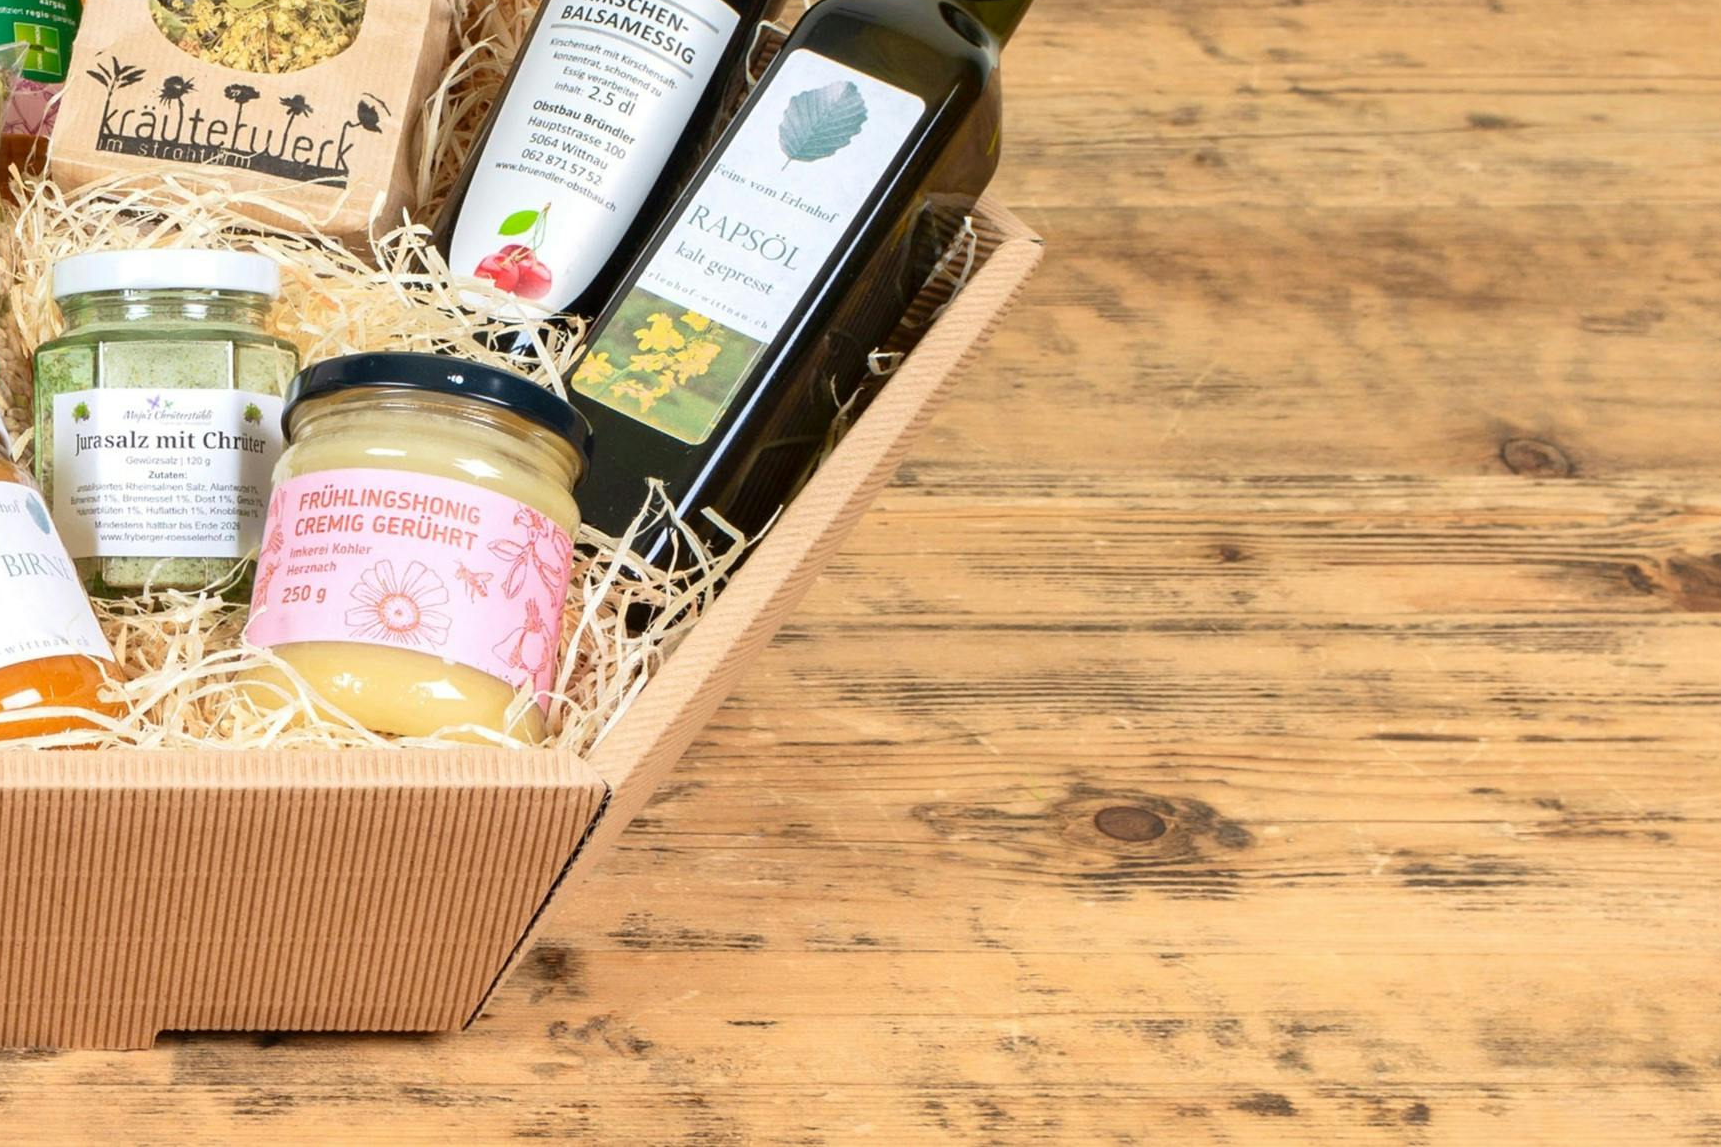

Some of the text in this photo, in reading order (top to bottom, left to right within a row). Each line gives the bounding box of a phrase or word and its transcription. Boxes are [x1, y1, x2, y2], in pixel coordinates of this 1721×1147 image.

[549, 37, 602, 55] Kirschensaft
[602, 46, 619, 59] mit
[560, 3, 697, 66] BALSAMESSIG
[552, 51, 663, 98] konzentrat, schonend zu
[562, 65, 640, 102] Essig verarbeitet
[587, 85, 617, 108] 2.5
[617, 100, 637, 117] dl
[100, 103, 355, 172] kräuterwerk
[527, 115, 627, 161] Hauptstrasse 100
[532, 99, 636, 146] Obstbau Bründler
[520, 147, 603, 187] 062 871 57 52
[528, 132, 609, 171] 5064 Wittnau
[494, 160, 617, 214] www.bruendler-obstbau.ch
[712, 162, 840, 224] Feins vom Erlenhof
[686, 203, 801, 271] RAPSÖL
[674, 240, 775, 296] kalt gepresst
[74, 430, 267, 457] Jurasalz mit Chrüter
[125, 455, 212, 468] Gewürzsalz 120 g
[125, 482, 184, 492] Rheinsalinen
[148, 470, 189, 480] Zutaten:
[298, 484, 481, 526] FRÜHLINGSHONIG
[94, 520, 218, 531] Mindestens haltbar bis Ende
[293, 513, 479, 552] CREMIG GERÜHRT
[286, 561, 338, 577] Herznach
[288, 542, 374, 560] Imkerei Kohler
[281, 584, 327, 605] 250 g
